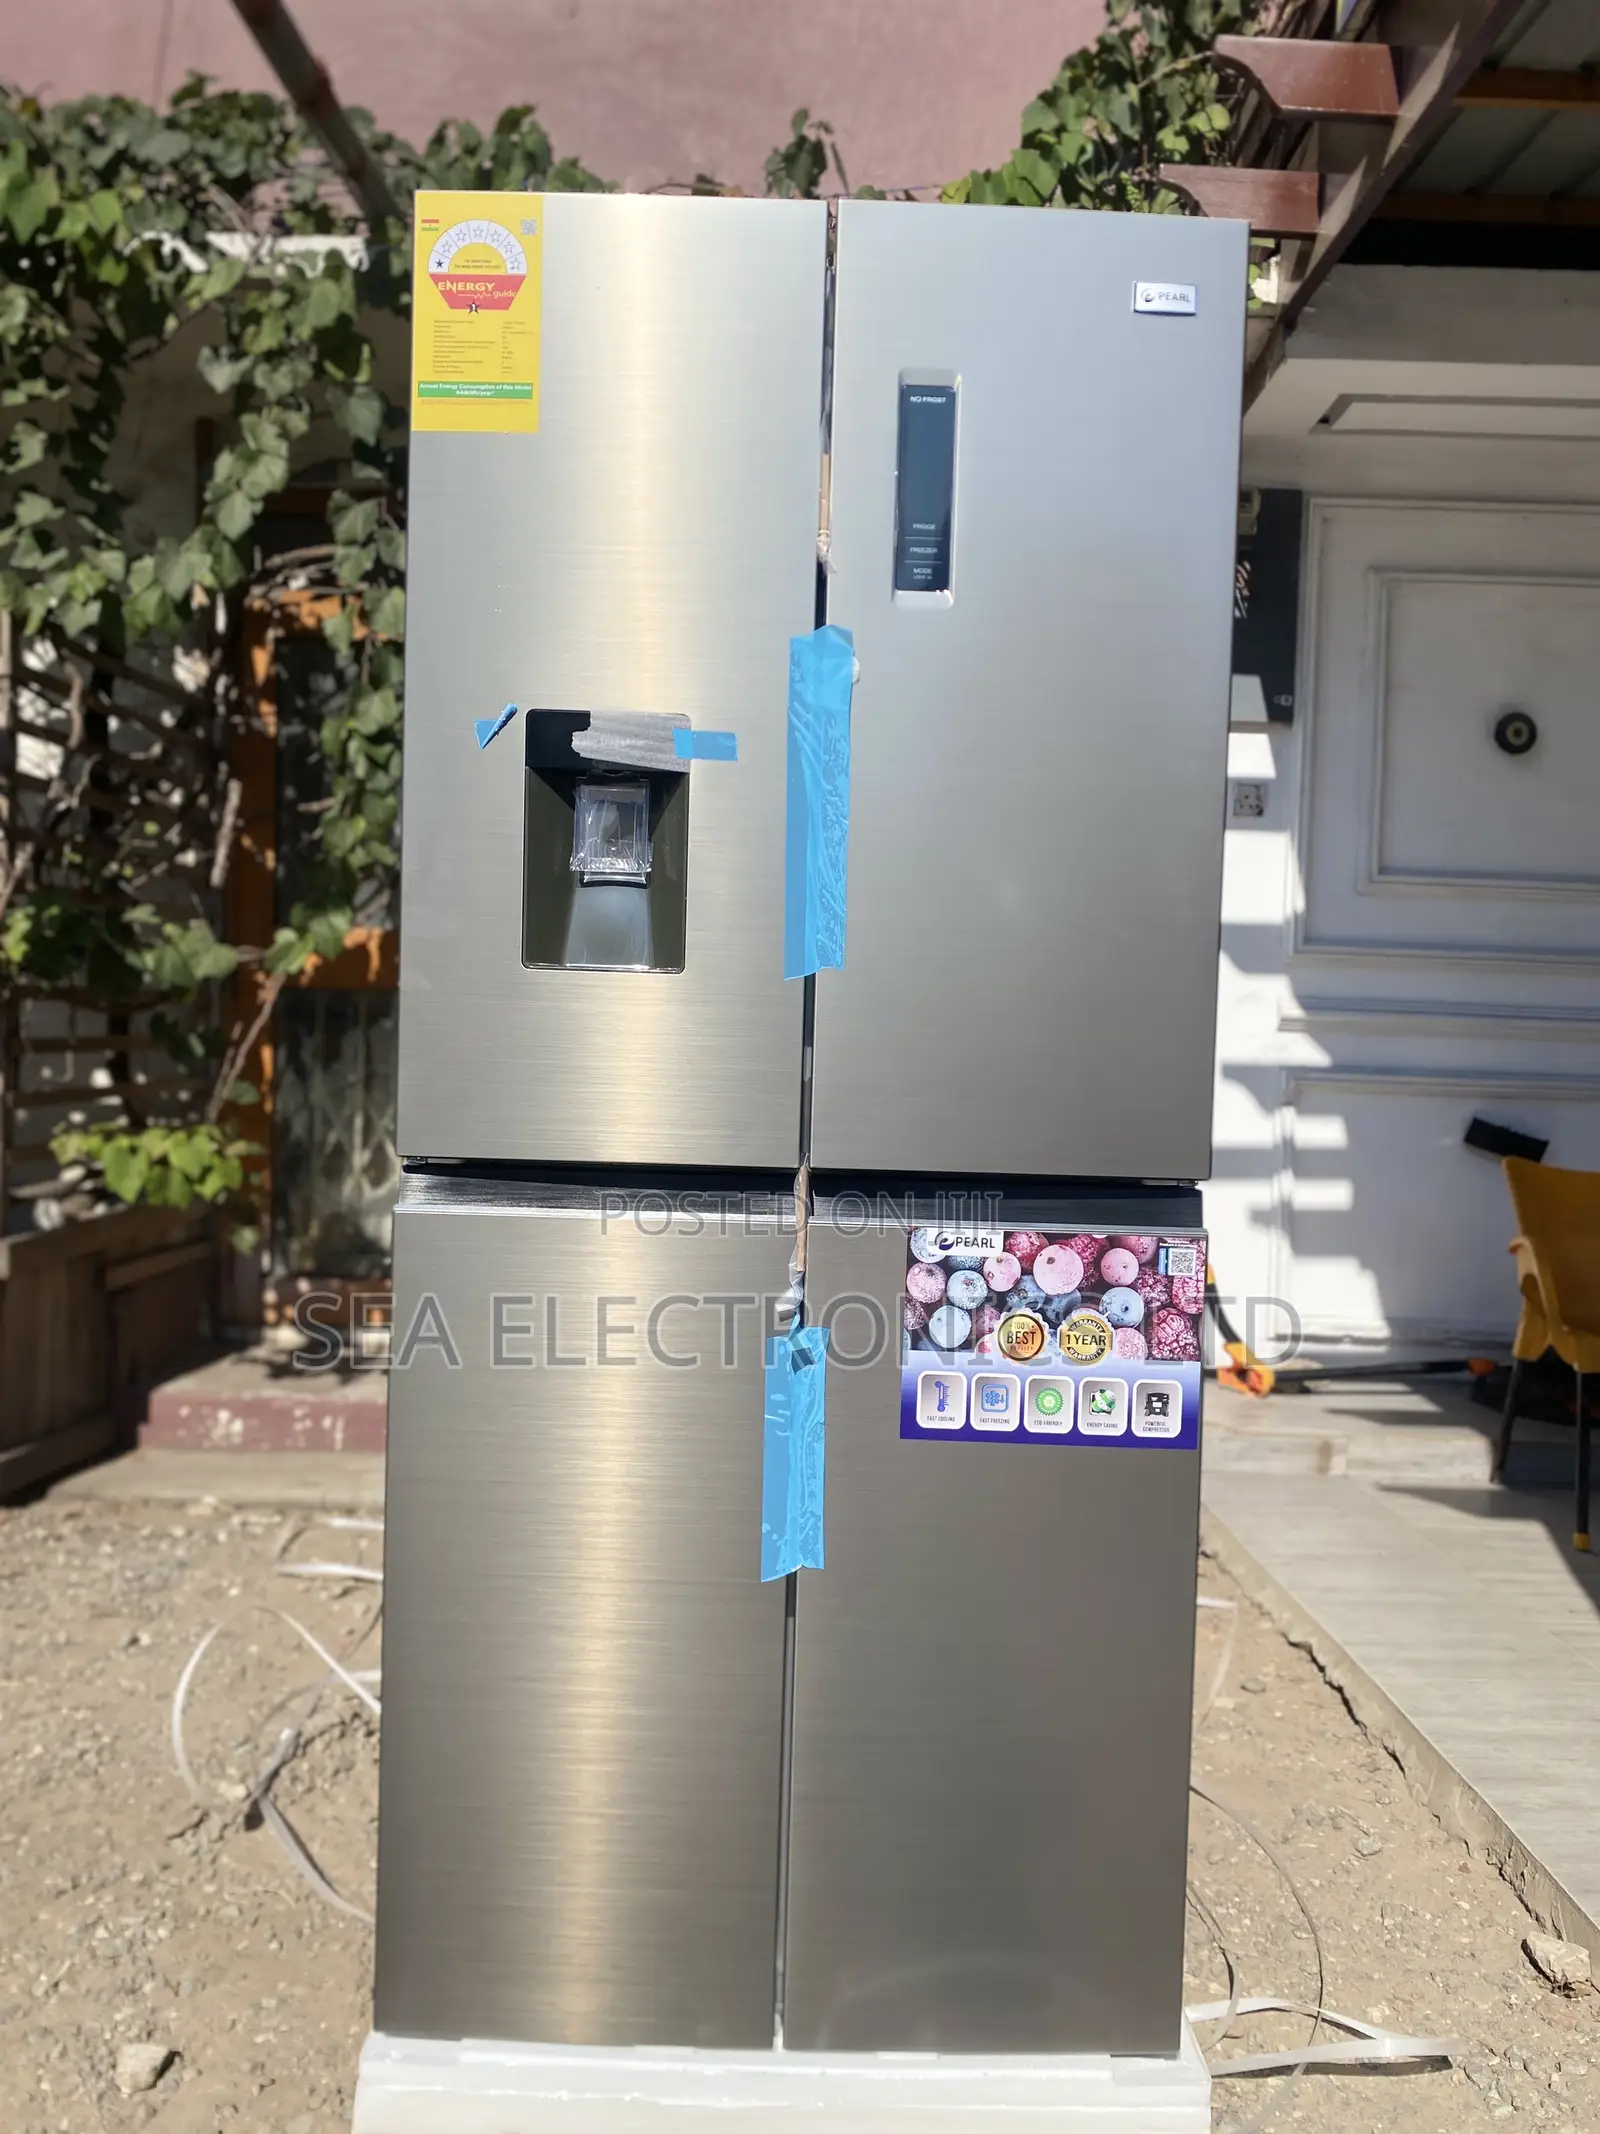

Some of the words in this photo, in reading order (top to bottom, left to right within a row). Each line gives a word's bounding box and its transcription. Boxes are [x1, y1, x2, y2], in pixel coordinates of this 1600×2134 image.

[437, 280, 495, 294] ENERGY
[493, 289, 518, 300] guide
[1158, 291, 1193, 303] PEARL
[955, 1236, 996, 1248] PEARL
[1069, 1319, 1105, 1332] WARRANTY
[1007, 1330, 1037, 1345] BEST
[1065, 1333, 1071, 1345] 1
[1073, 1334, 1107, 1347] YEAR
[1068, 1347, 1104, 1361] WARRANTY
